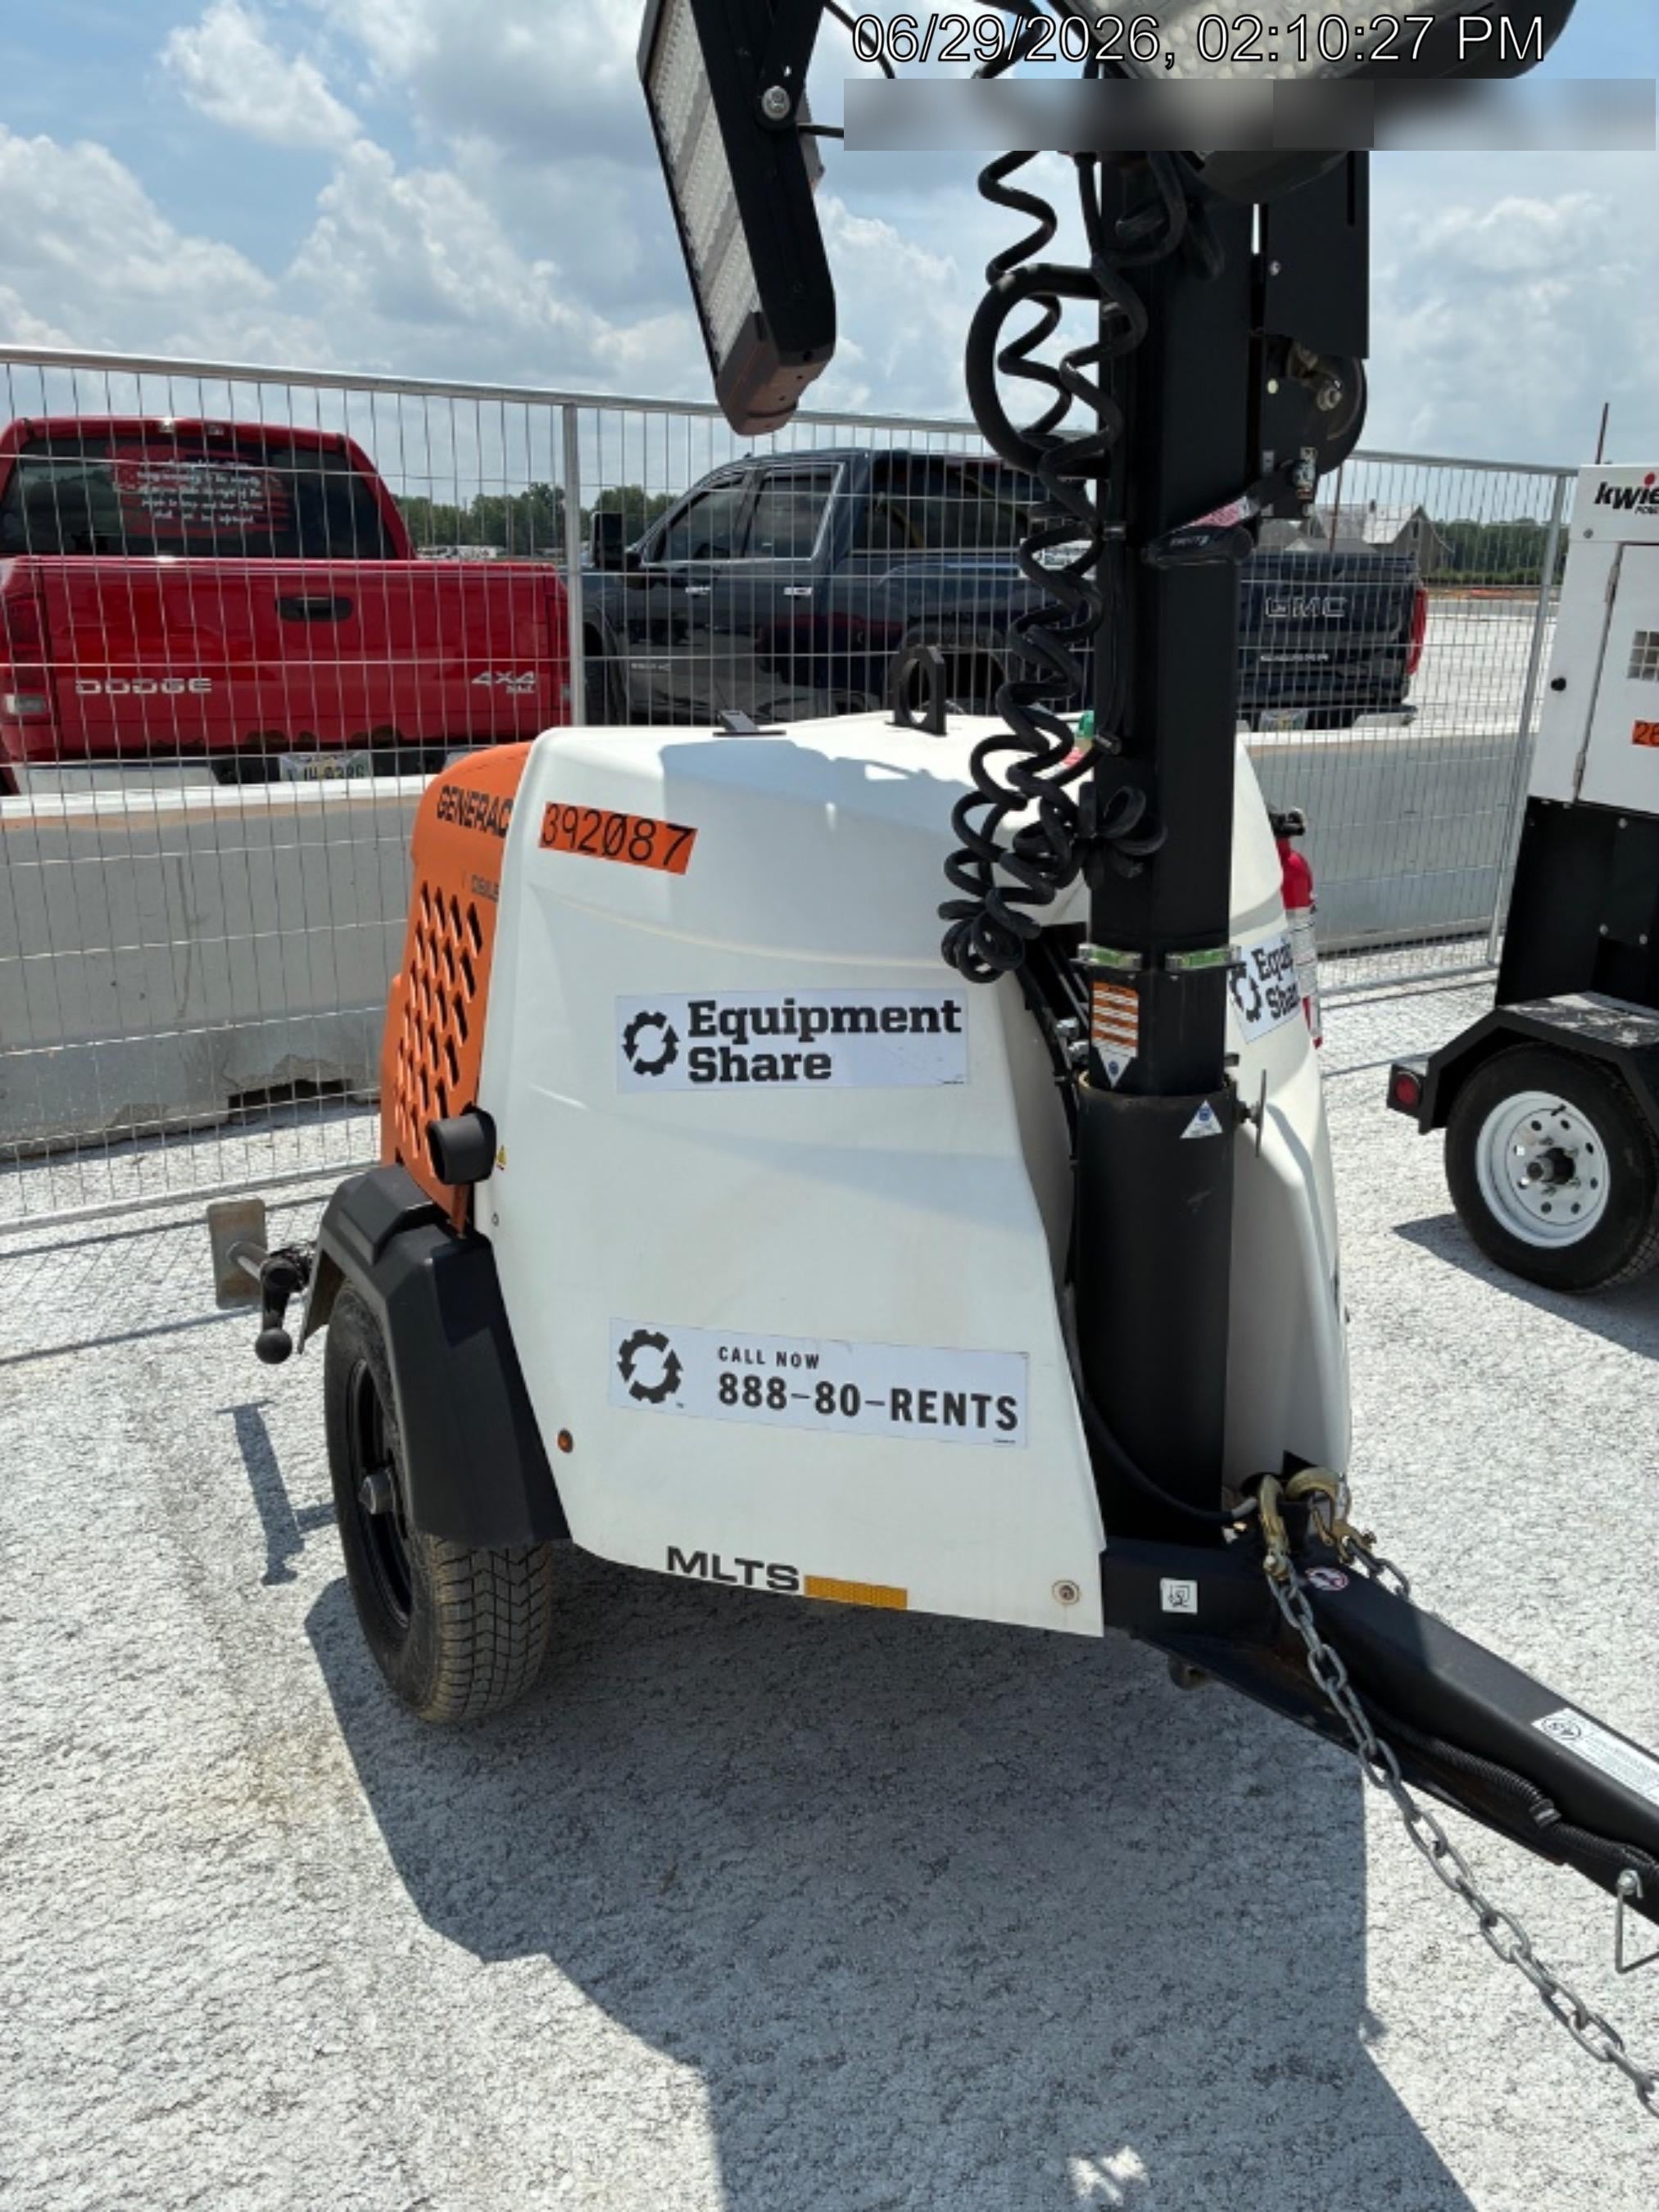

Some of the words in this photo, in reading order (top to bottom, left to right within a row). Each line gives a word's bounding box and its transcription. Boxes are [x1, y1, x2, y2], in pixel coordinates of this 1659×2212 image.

[1265, 596, 1347, 618] GMC
[75, 678, 212, 695] DODGE
[437, 785, 514, 839] GENERAC
[542, 803, 698, 866] 392087
[687, 997, 962, 1045] Equipment
[687, 1045, 832, 1083] Share
[718, 1346, 766, 1365] CALL
[776, 1350, 819, 1370] NOW
[718, 1372, 1018, 1431] 888-80-RENTS
[667, 1545, 800, 1591] MLTS
